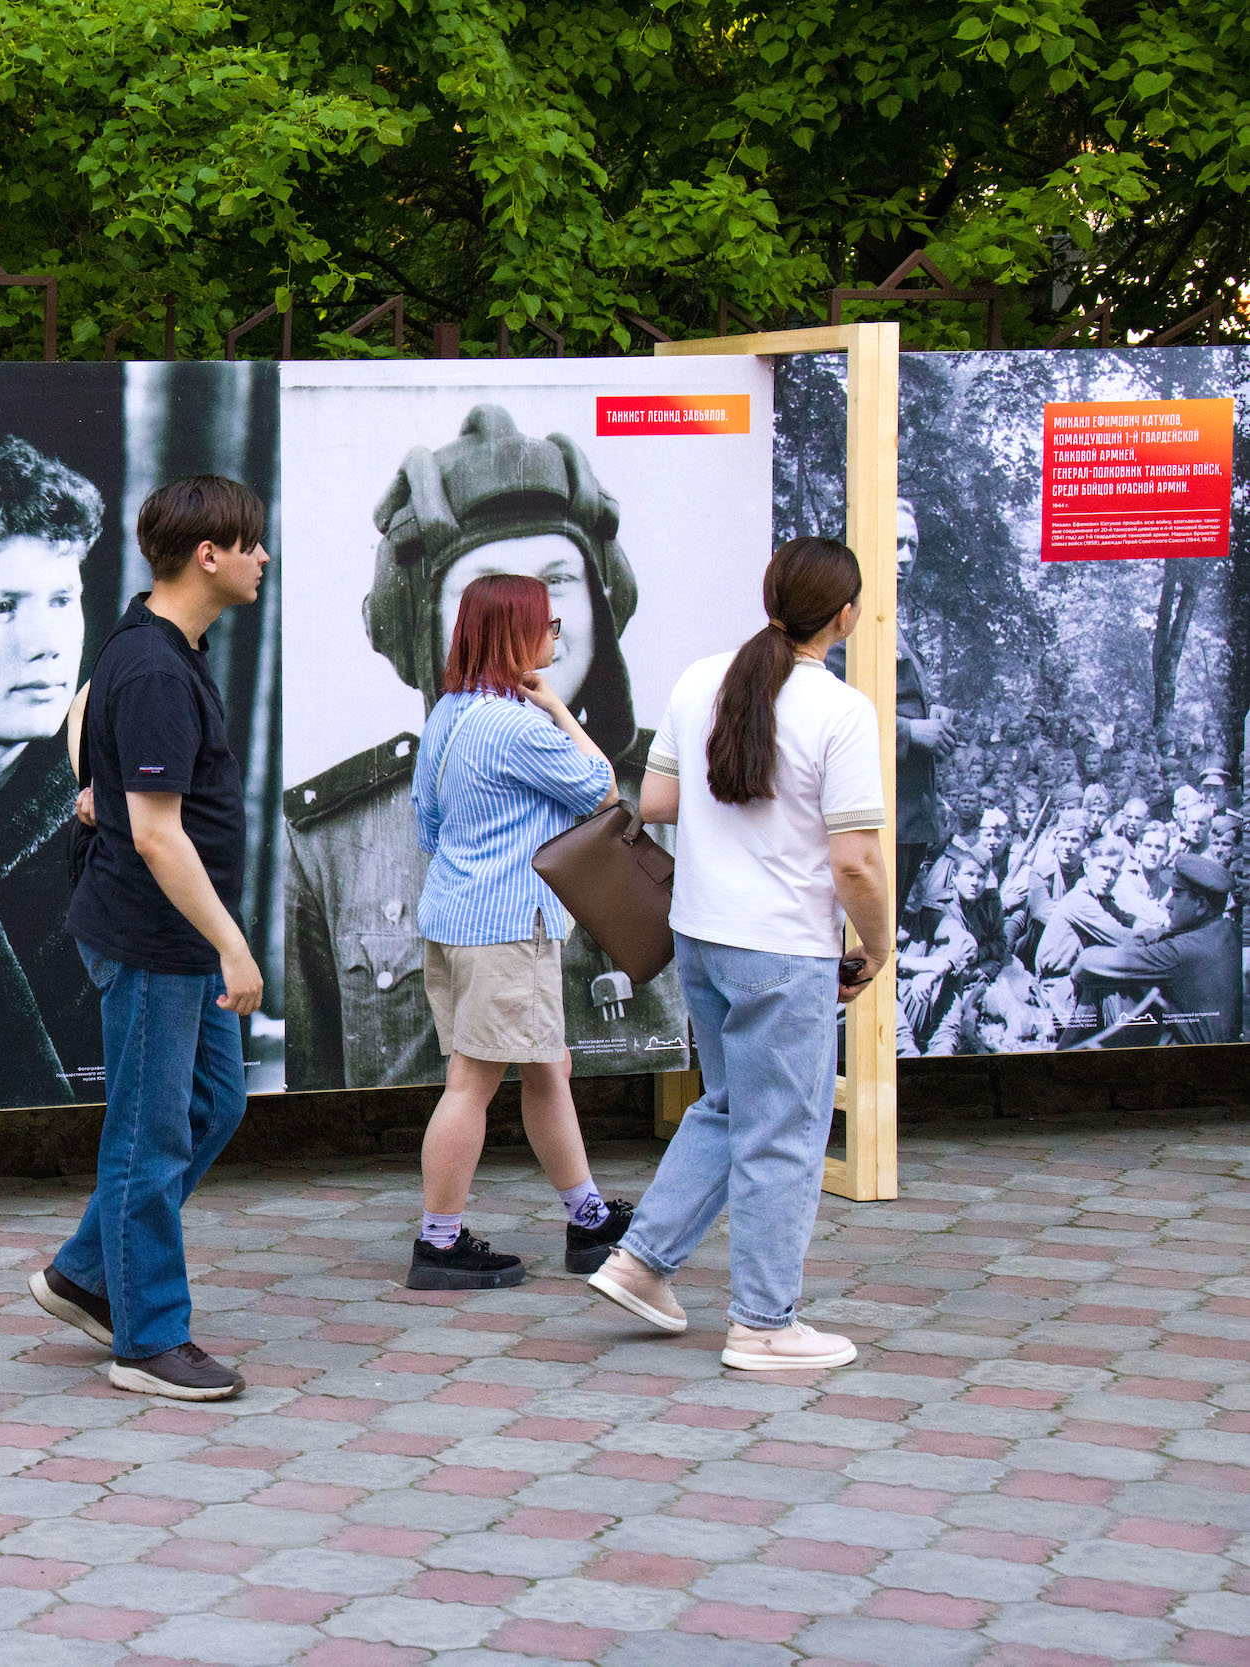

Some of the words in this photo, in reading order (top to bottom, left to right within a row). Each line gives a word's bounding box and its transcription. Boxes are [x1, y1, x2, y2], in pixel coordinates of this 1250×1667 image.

[607, 411, 645, 422] ТАНКИСТ
[648, 410, 681, 423] ЛЕОНИД
[683, 409, 728, 421] ЗАВЬЯЛОВ.
[1054, 416, 1090, 428] МИХАИЛ
[1093, 415, 1139, 427] ЕФИМОВИЧ
[1143, 414, 1182, 427] КАТУКОВ,
[1054, 431, 1122, 446] КОМАНДУЮЩИЙ
[1125, 430, 1138, 444] 1-Й
[1142, 429, 1199, 443] ГВАРДЕЙСКОЙ
[1054, 449, 1096, 462] ТАНКОВОЙ
[1100, 447, 1137, 462] АРМИЕЙ,
[1053, 466, 1142, 479] ГЕНЕРАЛ-ПОЛКОВНИК
[1145, 464, 1190, 476] ТАНКОВЫХ
[1193, 463, 1222, 476] ВОЙСК,
[1053, 483, 1079, 497] СРЕДИ
[1082, 482, 1113, 496] БОЙЦОВ
[1116, 480, 1154, 494] КРАСНОЙ
[1157, 481, 1189, 493] АРМИИ.
